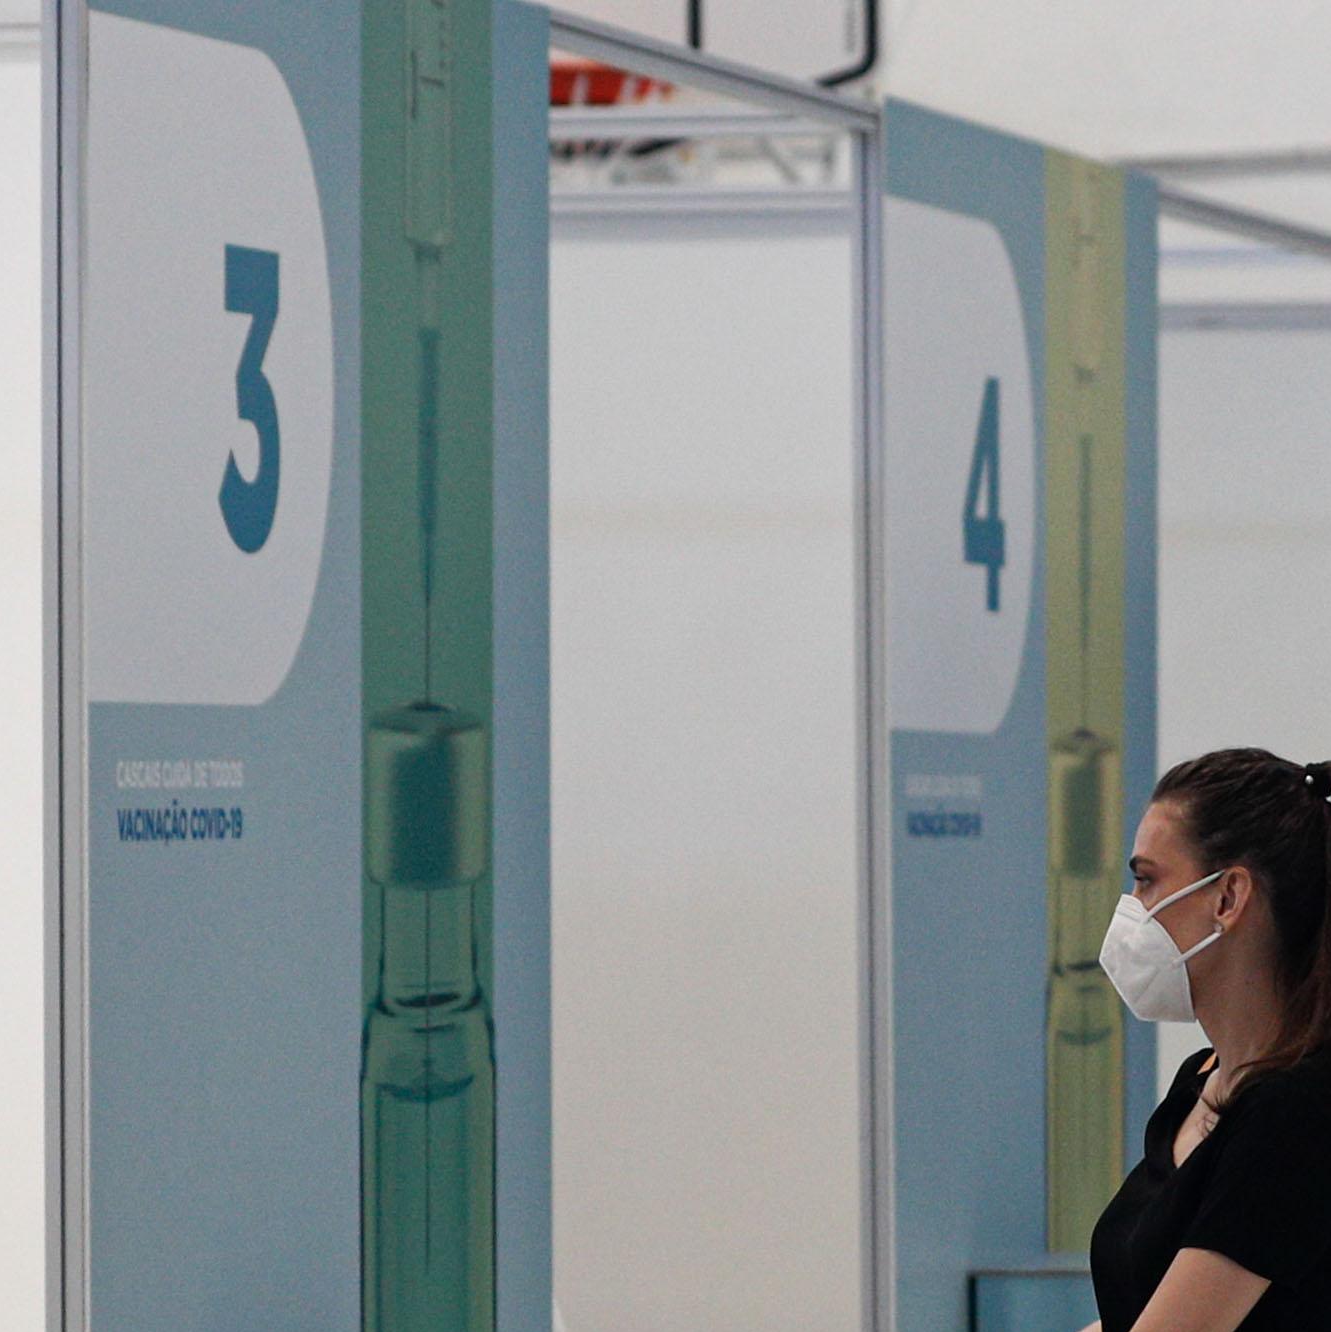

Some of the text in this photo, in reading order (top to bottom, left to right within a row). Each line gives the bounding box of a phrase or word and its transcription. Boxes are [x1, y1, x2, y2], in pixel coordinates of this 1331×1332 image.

[218, 243, 281, 555] 3
[962, 377, 1006, 613] 4
[117, 799, 243, 846] VACINAÇÃO COVID-19
